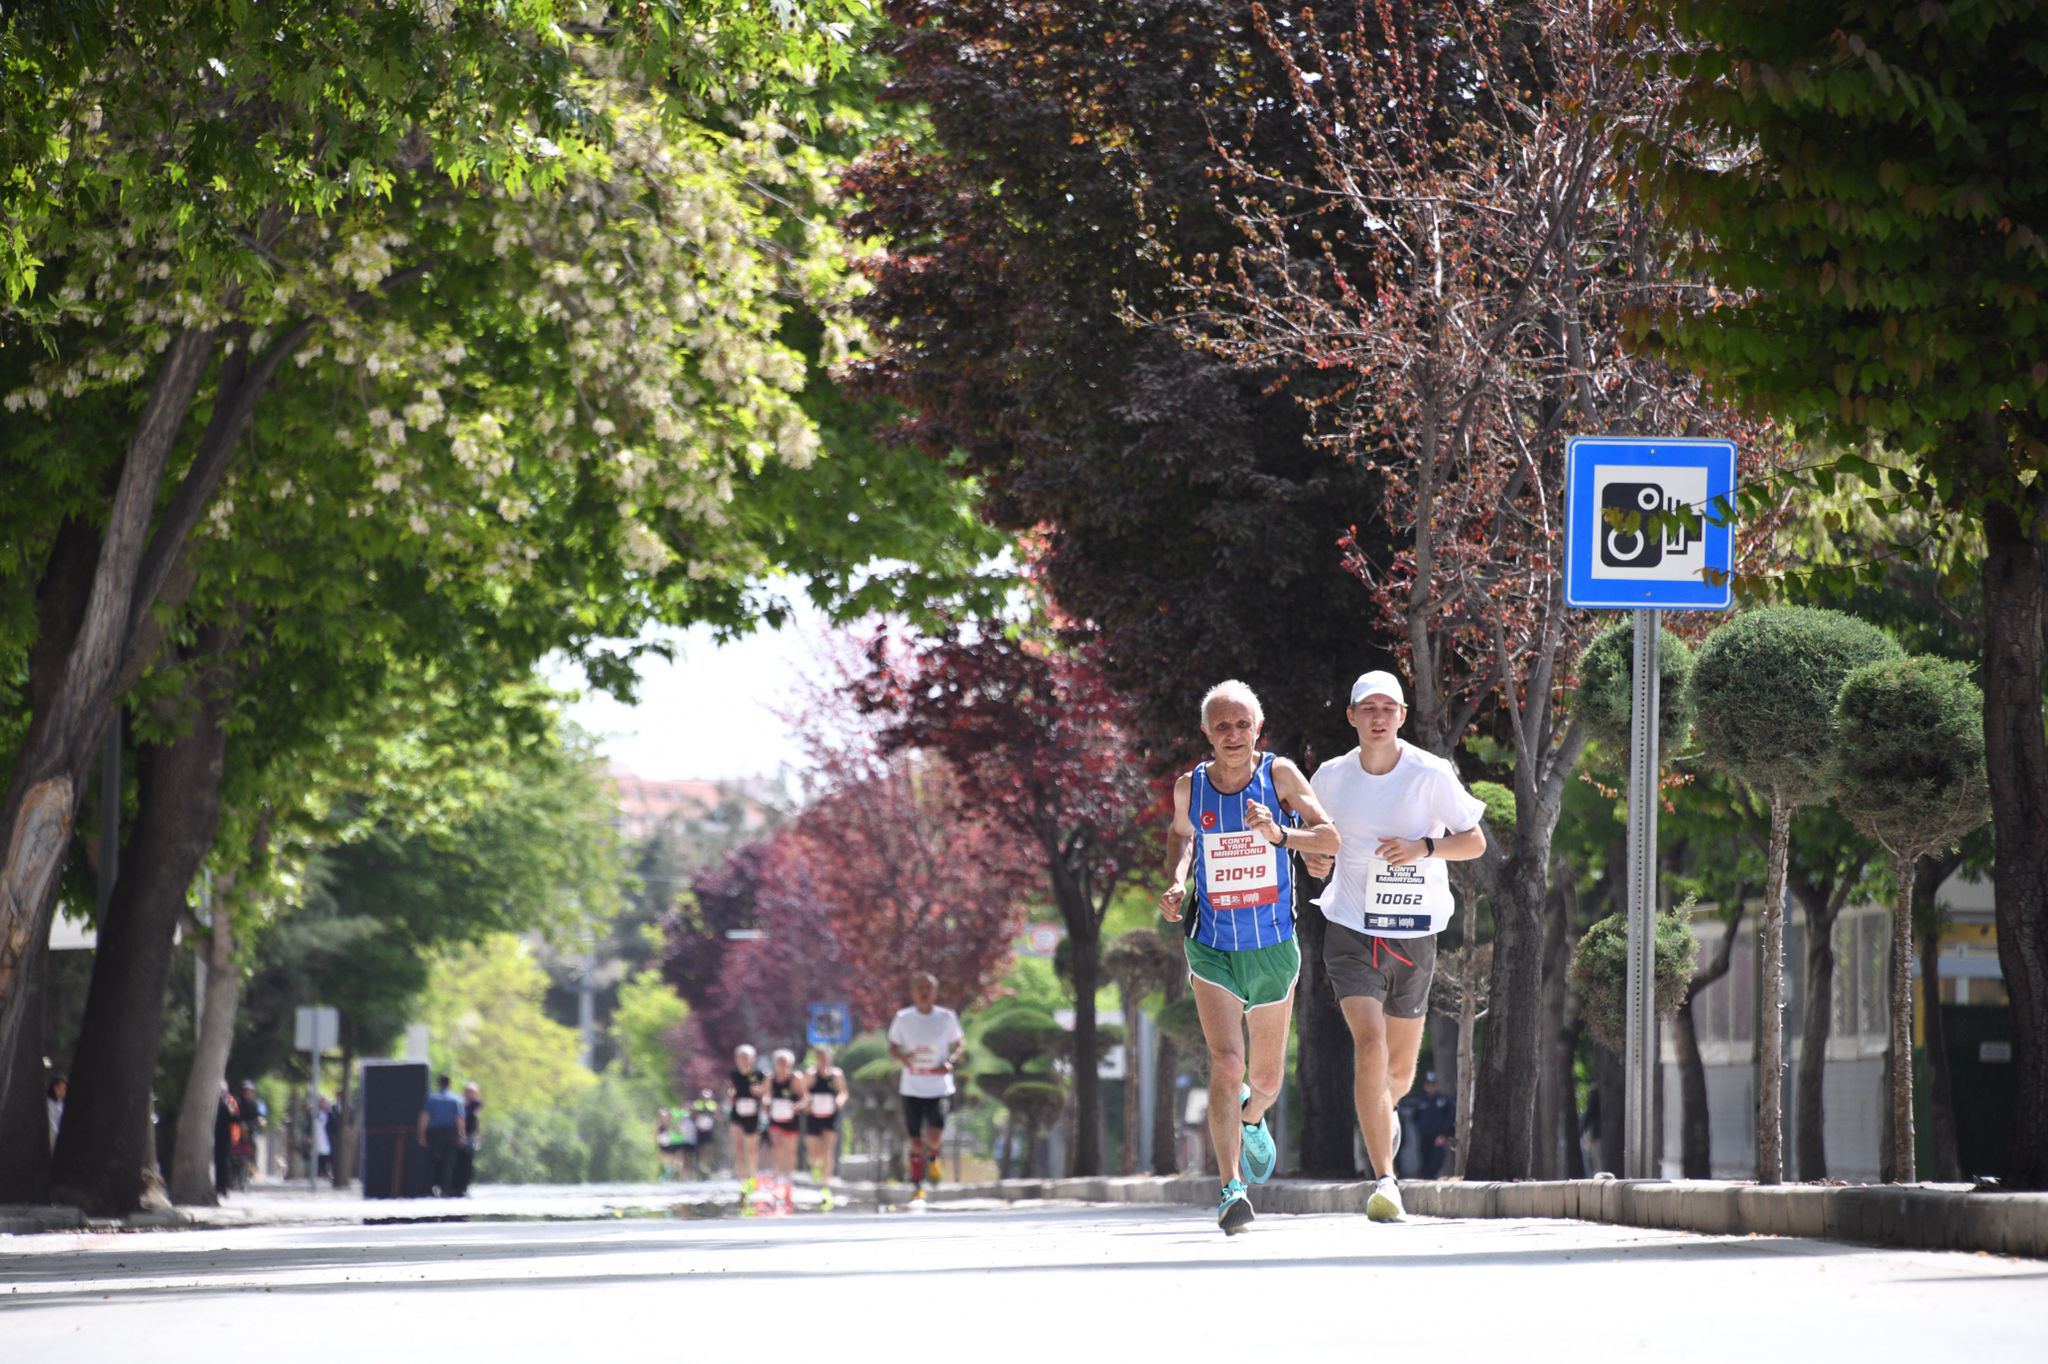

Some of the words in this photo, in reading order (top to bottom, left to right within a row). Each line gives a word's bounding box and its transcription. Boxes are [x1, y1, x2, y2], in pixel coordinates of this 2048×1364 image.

[1222, 836, 1252, 845] KONYA
[1214, 846, 1263, 857] MARATONU
[1215, 865, 1266, 882] 21049
[1375, 893, 1423, 905] 10062
